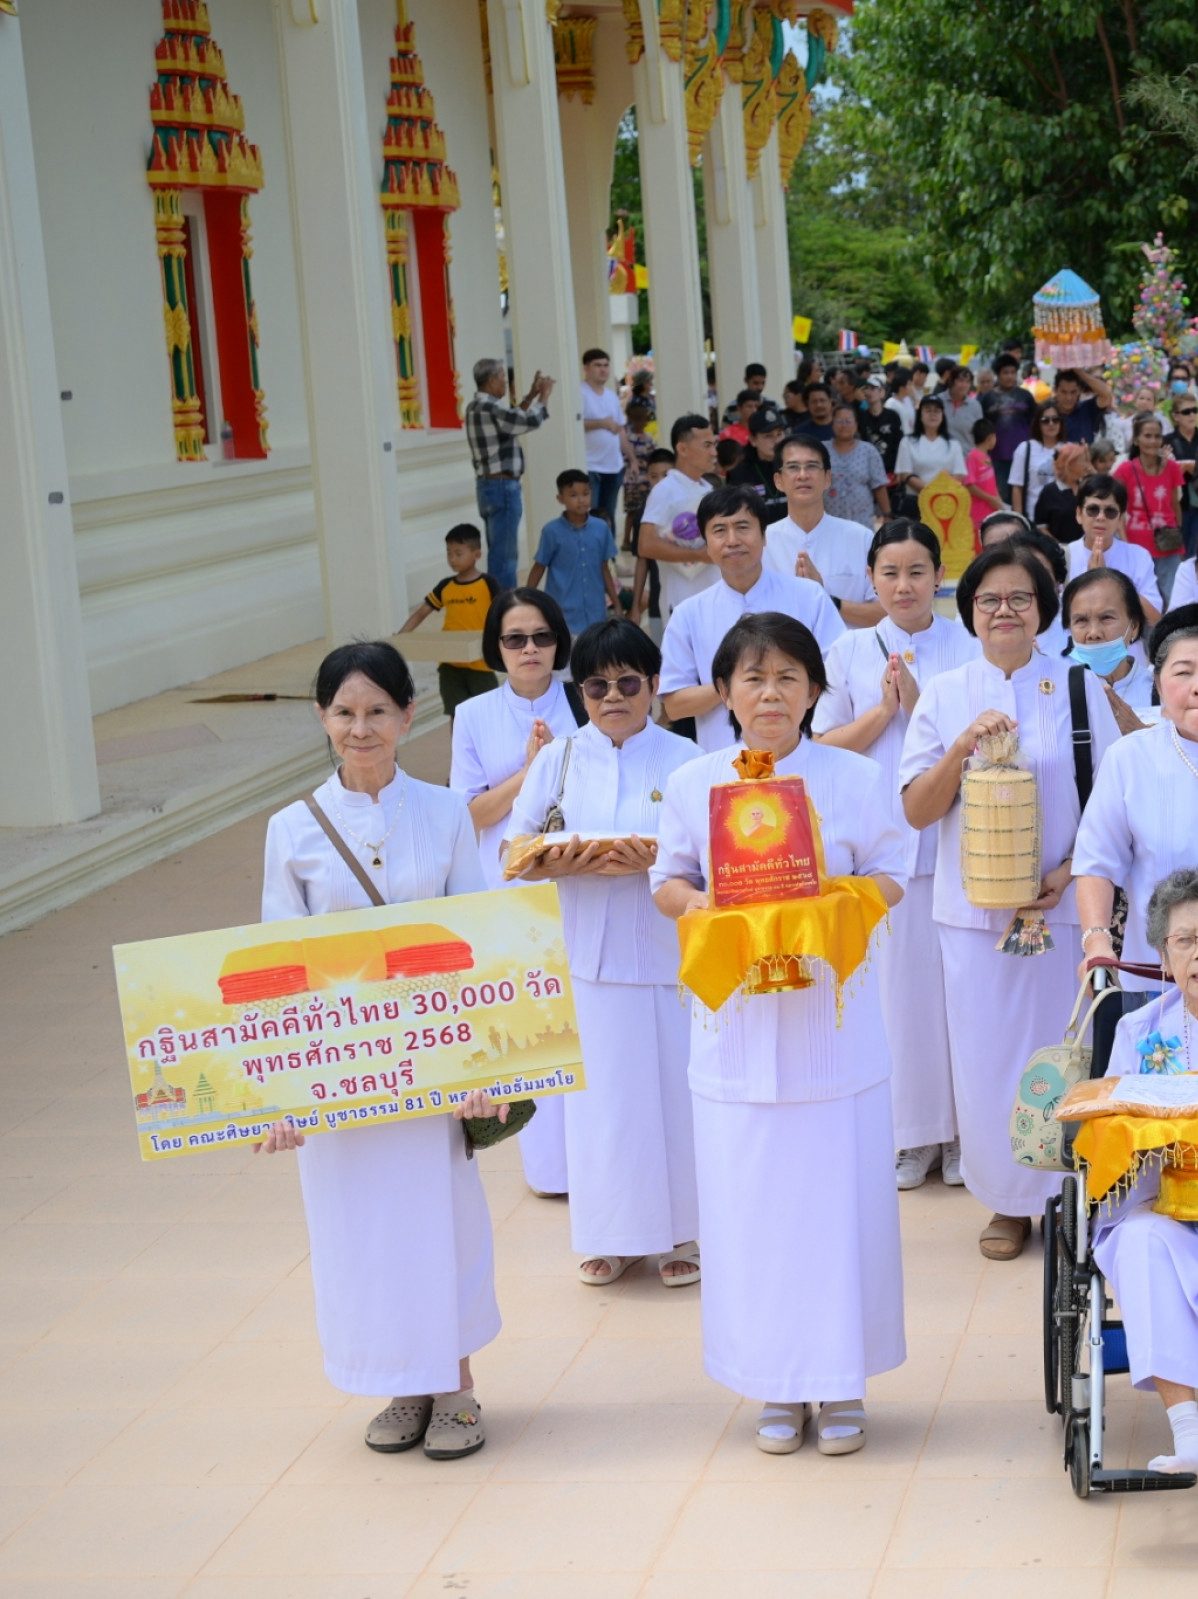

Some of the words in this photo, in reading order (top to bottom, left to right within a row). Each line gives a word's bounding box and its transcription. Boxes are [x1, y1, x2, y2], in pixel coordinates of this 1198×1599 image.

[138, 996, 400, 1064] กฐินสามัคคีทั่วไทย
[412, 980, 515, 1016] 30,000
[526, 970, 561, 998] วัด
[242, 1036, 393, 1083] พุทธศักราช
[404, 1022, 472, 1051] 2568
[311, 1058, 414, 1099] จ.ชลบุรี
[150, 1135, 182, 1151] โดย
[325, 1098, 399, 1128] บูชาธรรม
[405, 1096, 425, 1111] 81
[429, 1090, 442, 1107] ปี
